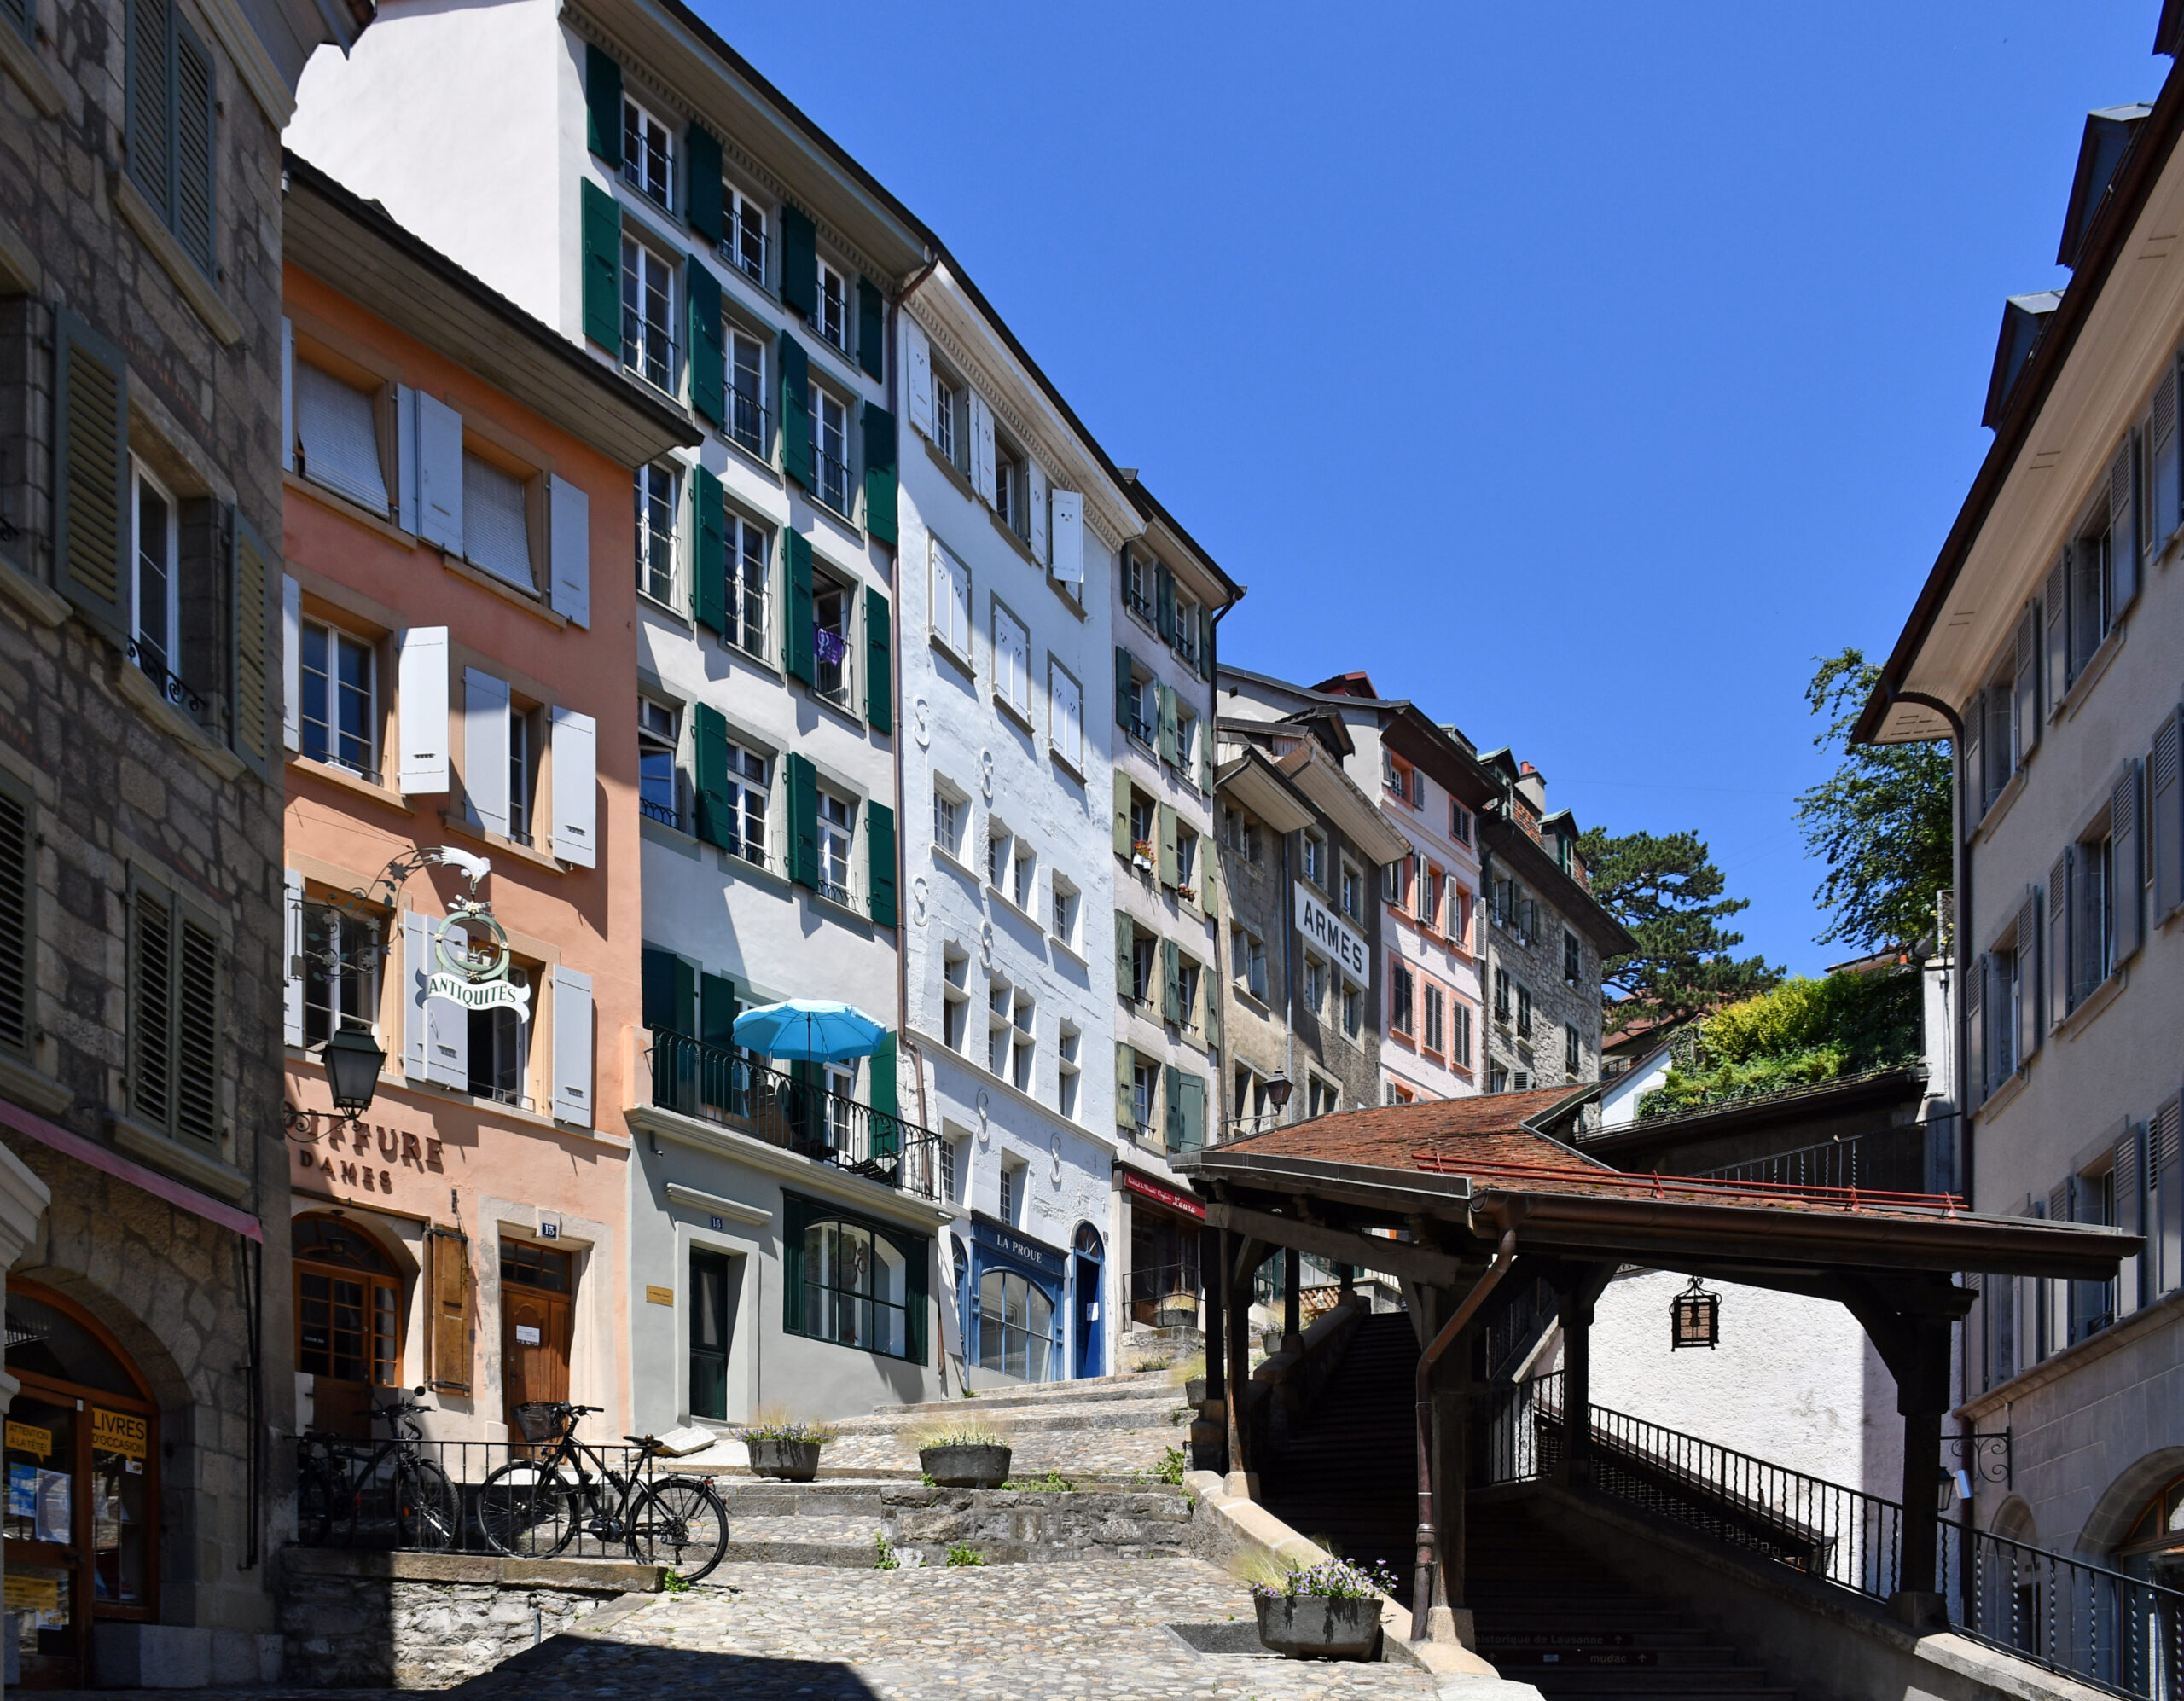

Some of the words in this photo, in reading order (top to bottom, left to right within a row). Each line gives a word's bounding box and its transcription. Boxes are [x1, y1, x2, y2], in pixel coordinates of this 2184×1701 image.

[1304, 900, 1362, 974] ARMES
[428, 978, 516, 1007] ANTIQUITÉS
[299, 1149, 392, 1186] DAMES
[1172, 1194, 1196, 1214] Laura
[544, 1224, 555, 1236] 13
[712, 1217, 721, 1228] 15
[996, 1234, 1009, 1250] LA
[1012, 1241, 1043, 1263] PROUE
[9, 1424, 49, 1440] ATTENTION
[92, 1411, 144, 1440] LIVRES
[92, 1433, 144, 1454] D'OCCASION
[1534, 1634, 1548, 1645] de
[1550, 1634, 1604, 1645] Lausanne
[1590, 1653, 1627, 1663] mudac
